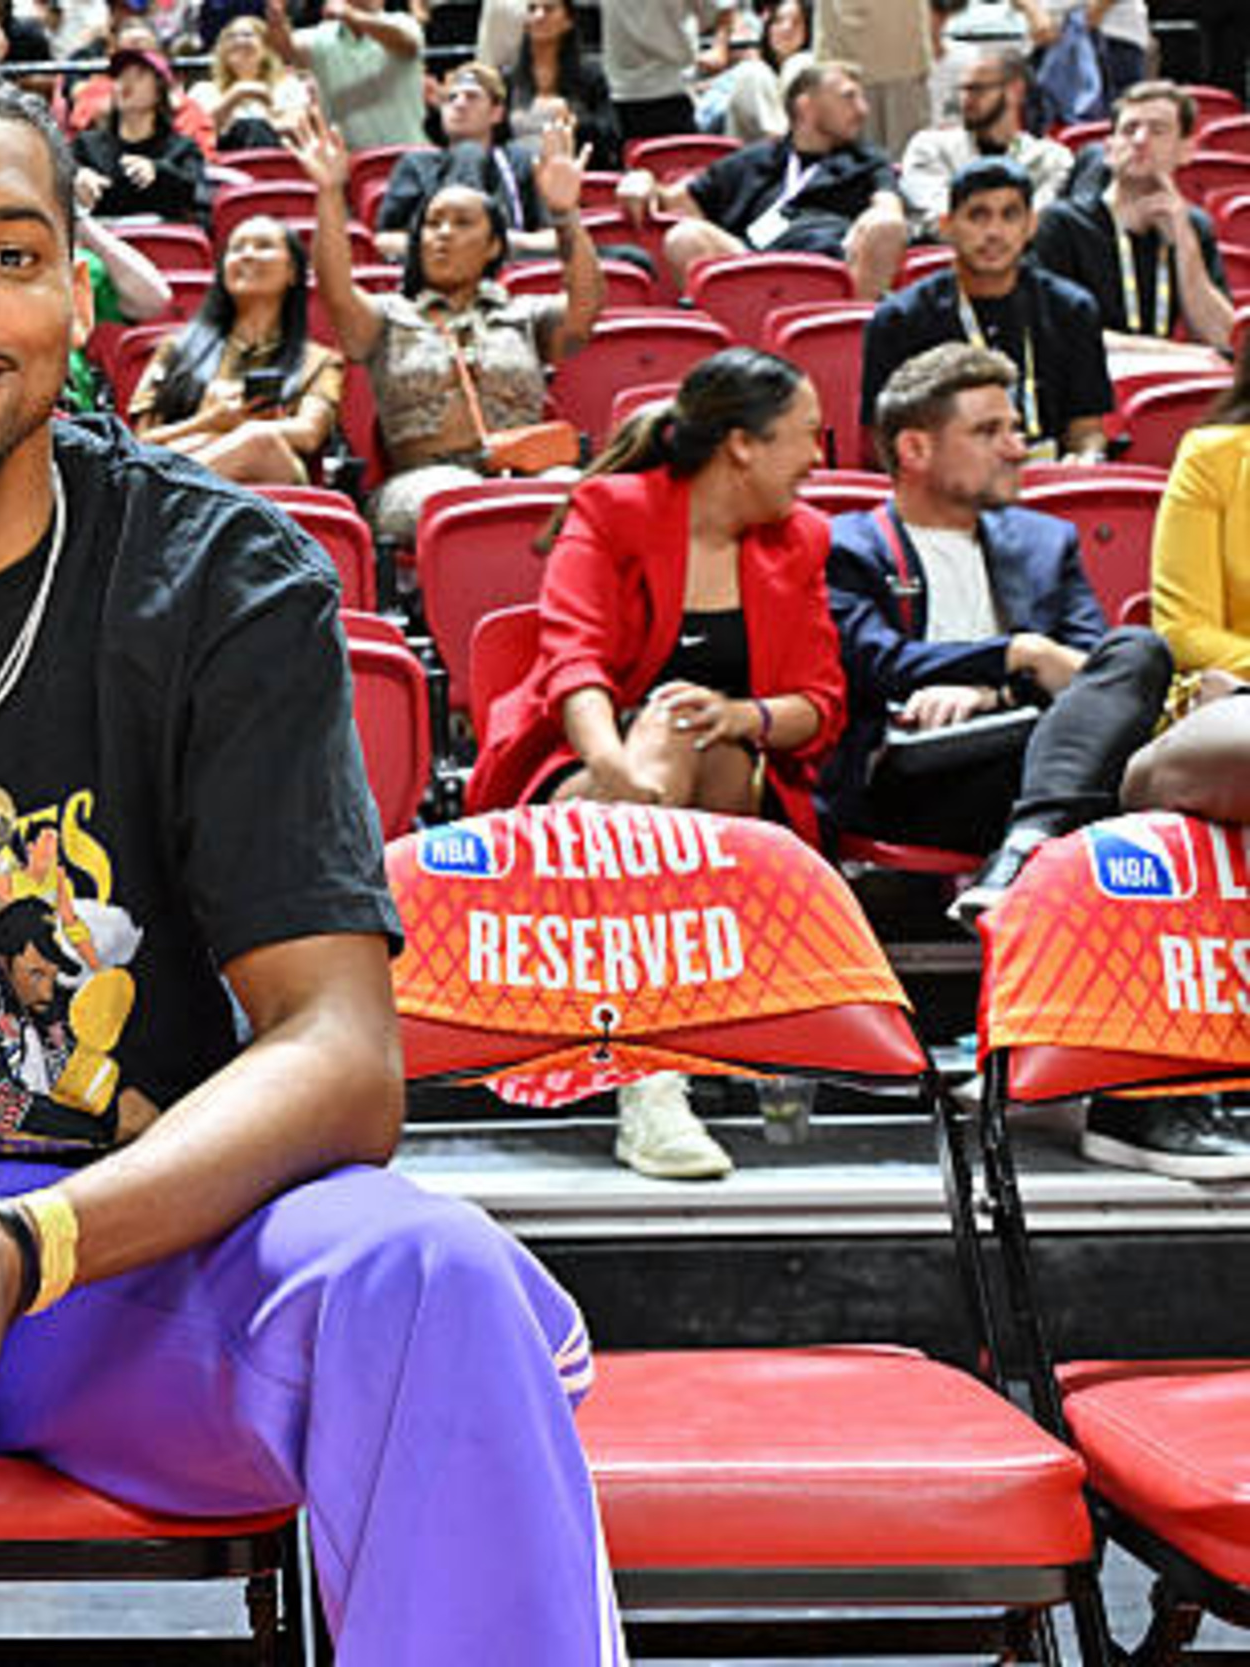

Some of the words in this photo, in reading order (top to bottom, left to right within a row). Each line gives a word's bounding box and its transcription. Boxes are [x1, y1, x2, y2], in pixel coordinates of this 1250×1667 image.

[431, 839, 478, 866] NBA
[528, 801, 736, 879] LEAGUE
[1107, 857, 1158, 888] NBA
[468, 906, 744, 993] RESERVED
